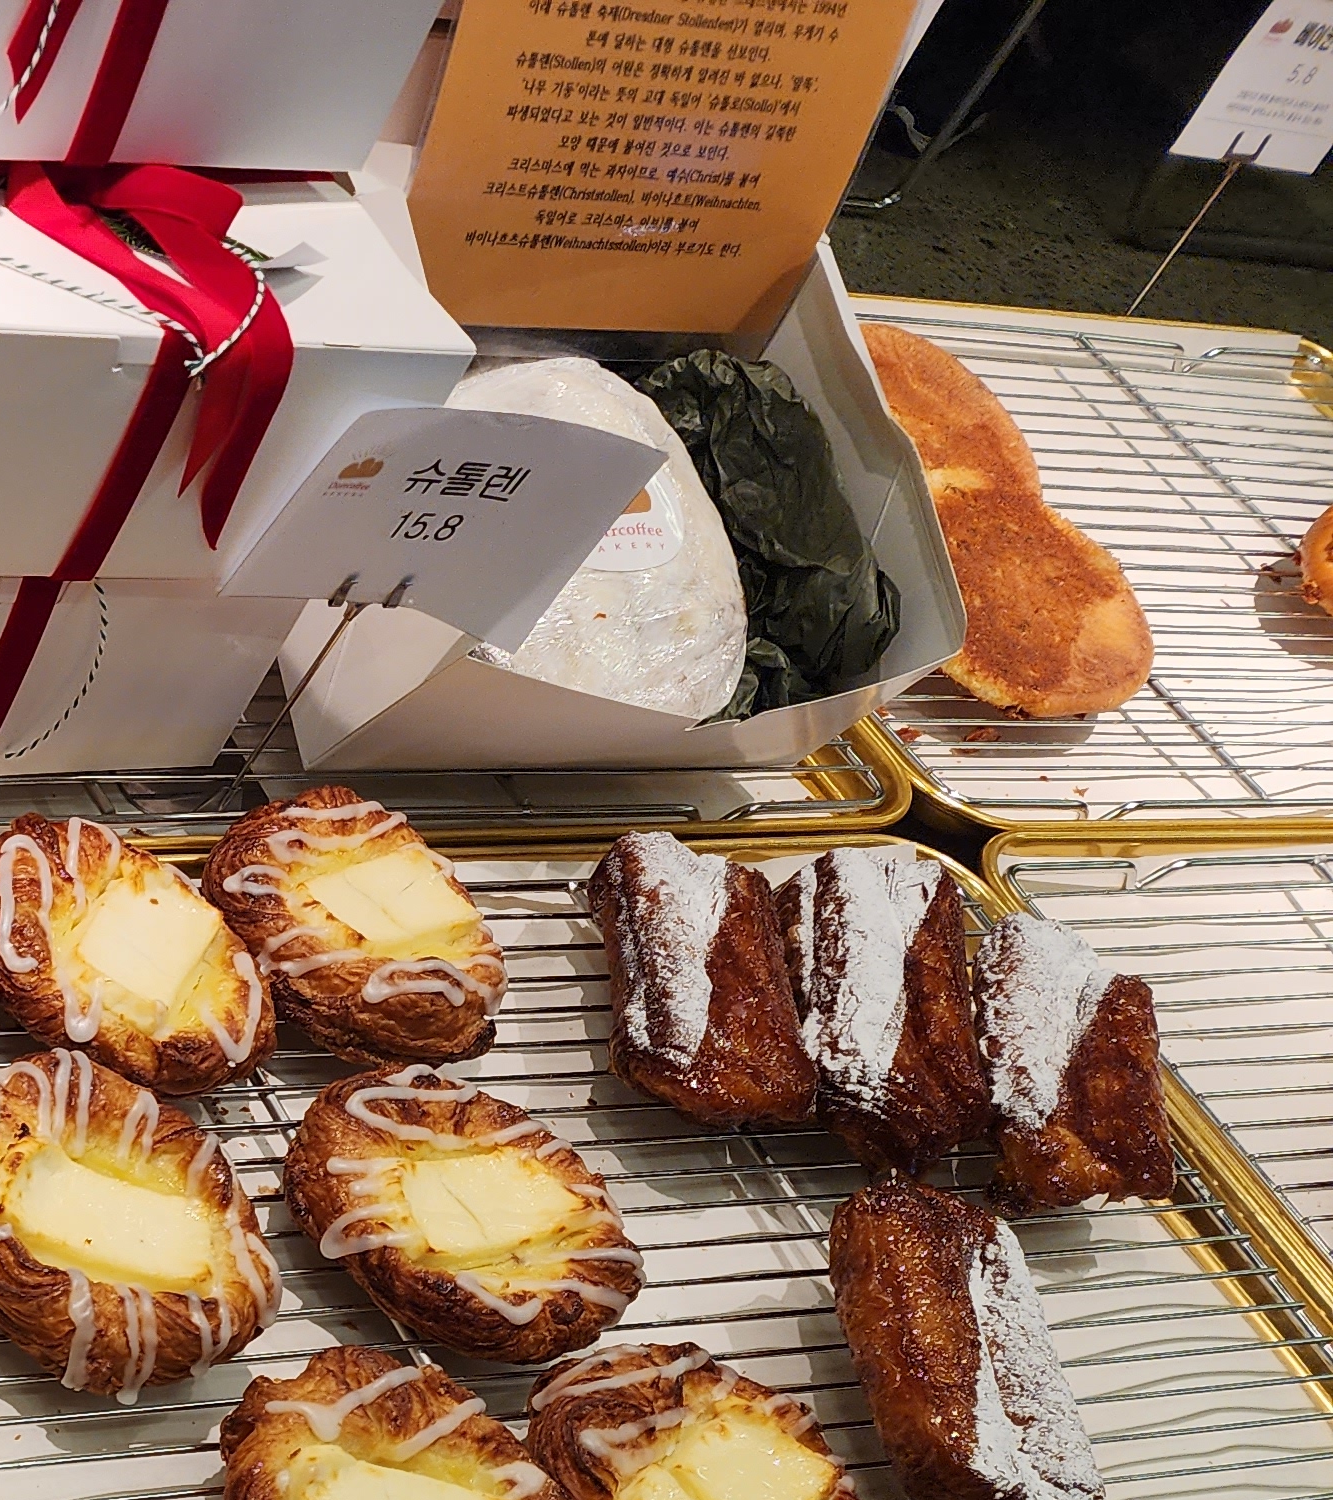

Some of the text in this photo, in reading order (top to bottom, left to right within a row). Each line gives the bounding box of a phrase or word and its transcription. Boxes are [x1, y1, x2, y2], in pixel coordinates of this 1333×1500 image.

[557, 1, 592, 19] 슈톨렌
[614, 32, 647, 51] 달하는
[679, 39, 722, 59] 슈톨렌을
[727, 45, 771, 63] 선보인다.
[516, 51, 607, 74] 슈톨렌(Stollen)의
[612, 59, 644, 78] 어원은
[650, 62, 693, 82] 정확하게
[698, 67, 731, 86] 알려진
[615, 86, 639, 103] 뜻의
[642, 89, 665, 106] 고대
[670, 91, 702, 109] 독일어
[506, 104, 797, 142] 파생되었다고 보는 것이 일반적이다. 이는 슈톨렌의 길쭉한
[558, 135, 729, 162] 모양 때문에 붙여진 것으로 보인다.
[507, 157, 575, 177] 크리스마스에
[580, 161, 601, 178] 먹는
[666, 168, 735, 186] 예수(Christ)를
[739, 172, 761, 189] 붙여
[535, 209, 578, 227] 독일어로
[581, 212, 633, 229] 크리스마스
[674, 241, 717, 257] 부르기도
[719, 243, 742, 258] 한다.
[402, 458, 531, 503] 슈톨렌
[390, 510, 465, 542] 15.8
[597, 541, 666, 553] AKERY
